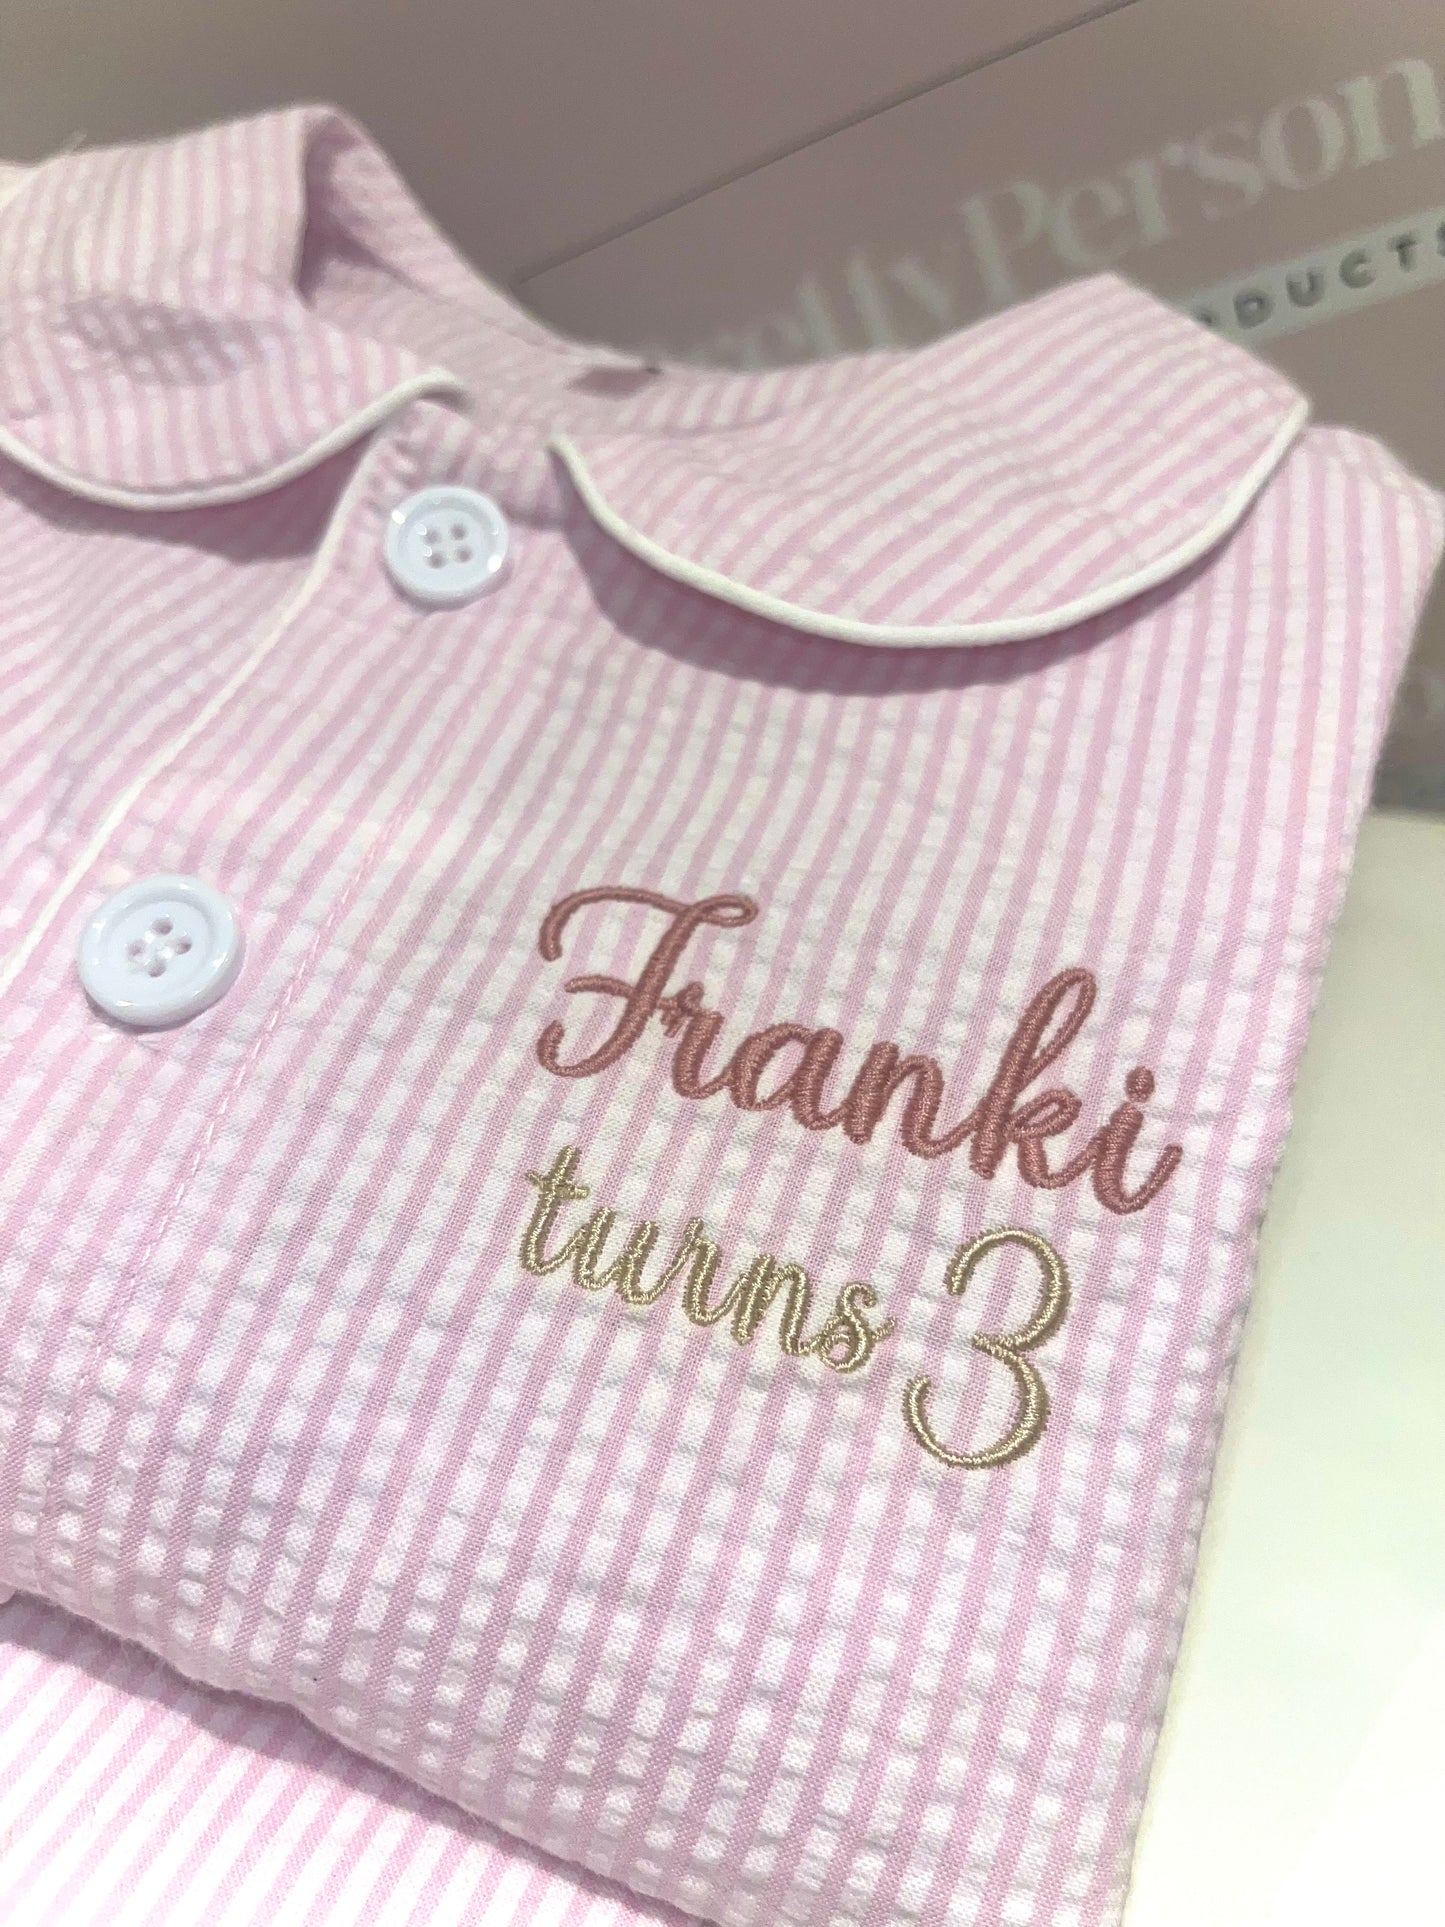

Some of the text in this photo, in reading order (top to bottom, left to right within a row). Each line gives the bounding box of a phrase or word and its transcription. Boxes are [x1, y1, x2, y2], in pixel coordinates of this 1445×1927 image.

[537, 885, 1183, 1215] Franki
[519, 1144, 1071, 1469] turns 3
